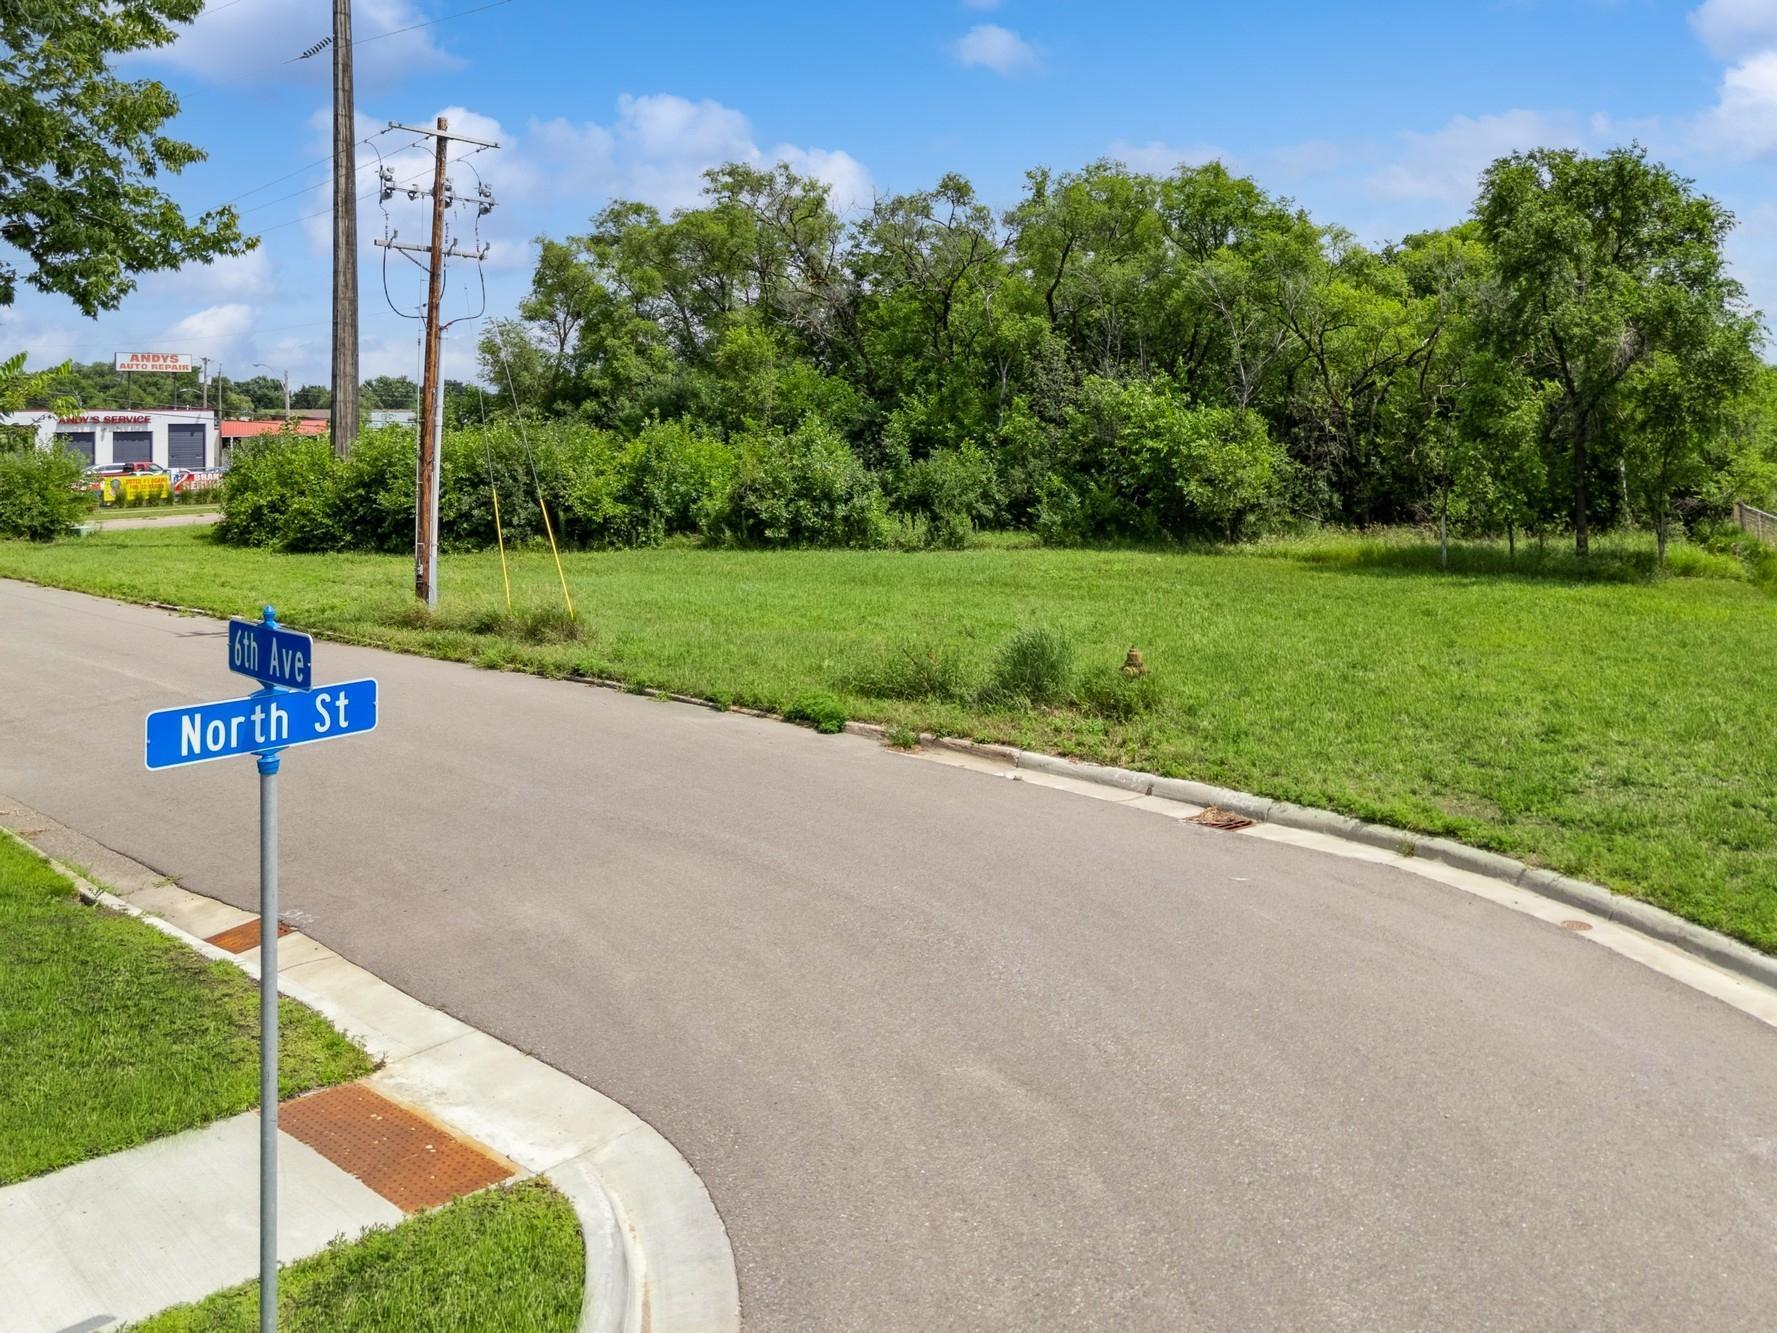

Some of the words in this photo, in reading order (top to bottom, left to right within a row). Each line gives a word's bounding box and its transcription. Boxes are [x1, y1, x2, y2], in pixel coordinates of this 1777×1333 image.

[130, 353, 179, 363] ANDYS
[103, 415, 152, 424] SERVICE
[194, 473, 223, 481] BRAK
[234, 629, 259, 672] 6th
[269, 637, 304, 683] Ave
[181, 702, 289, 757] North
[314, 690, 349, 734] St
